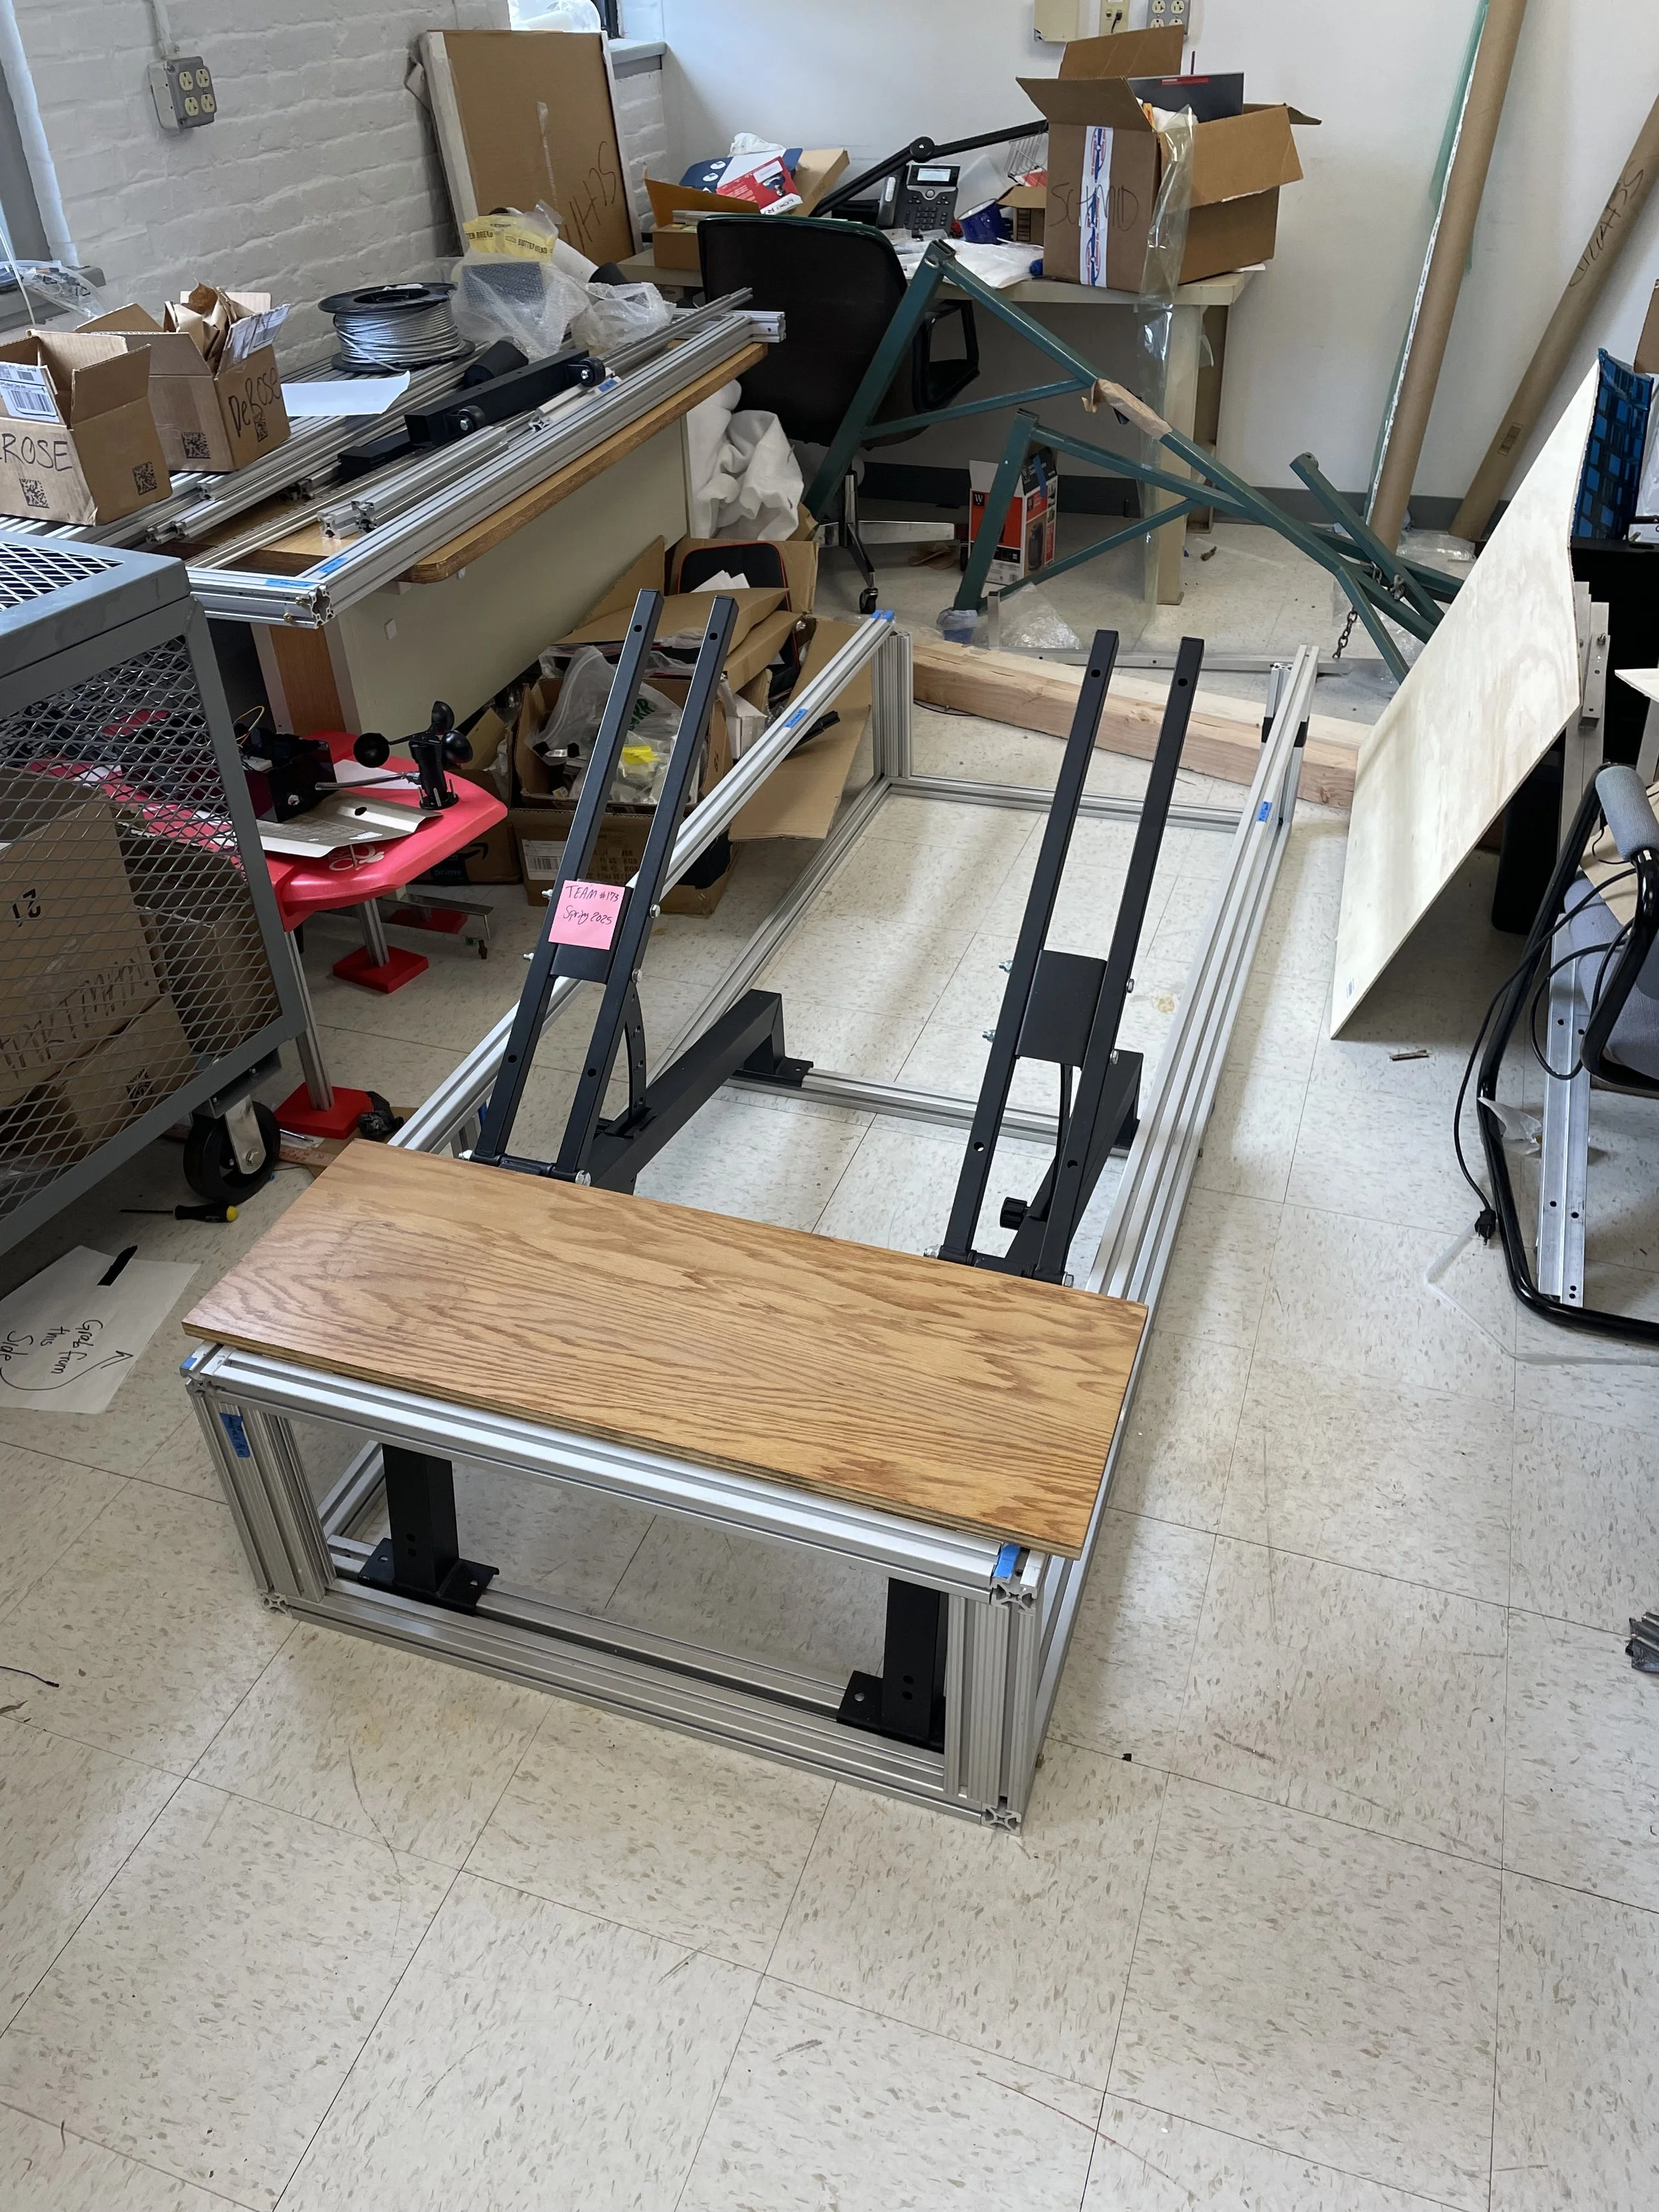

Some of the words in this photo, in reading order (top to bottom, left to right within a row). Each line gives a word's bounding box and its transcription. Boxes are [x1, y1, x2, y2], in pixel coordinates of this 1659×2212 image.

[0, 433, 73, 472] ROSE
[565, 885, 598, 900] TEAM
[599, 891, 619, 902] #173
[589, 911, 613, 925] 2025
